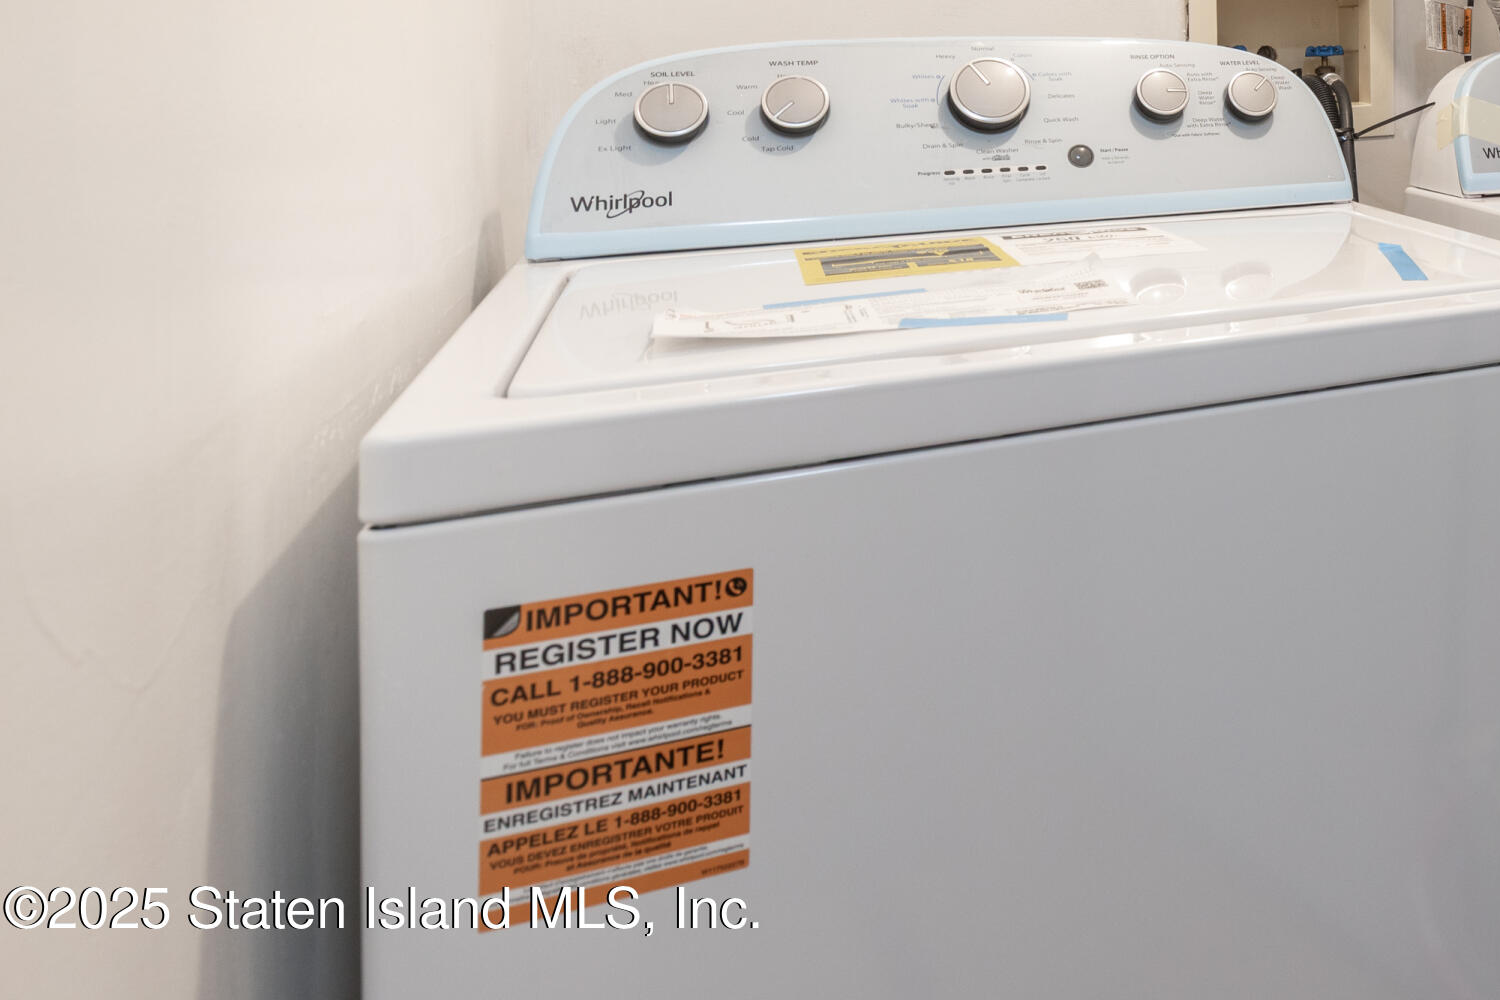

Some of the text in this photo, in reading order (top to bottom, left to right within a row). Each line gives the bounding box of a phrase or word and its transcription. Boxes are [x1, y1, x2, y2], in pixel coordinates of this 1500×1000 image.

[614, 90, 633, 98] Med
[736, 83, 759, 91] Warm
[595, 118, 616, 127] Light
[727, 109, 745, 117] Cool
[1043, 116, 1061, 124] Quick
[610, 144, 632, 153] Light
[742, 135, 759, 143] Cold
[762, 144, 794, 154] Tap Cold
[975, 147, 995, 155] Clean
[570, 190, 673, 219] Whirlpool
[526, 579, 722, 632] IMPORTANT!
[495, 612, 744, 675] REGISTER NOW
[490, 645, 743, 707] CALL 1-888-900-3381
[494, 669, 744, 726] YOU MUST REGISTER YOUR PRODUCT
[506, 738, 725, 804] IMPORTANTE!
[484, 764, 747, 834] ENREGISTREZ MAINTENANT
[487, 789, 742, 857] APPELEZ LE 1-888-900-3381
[489, 805, 744, 871] VOUS DEVEZ ENREGISTRER VOTRE PRODUIT
